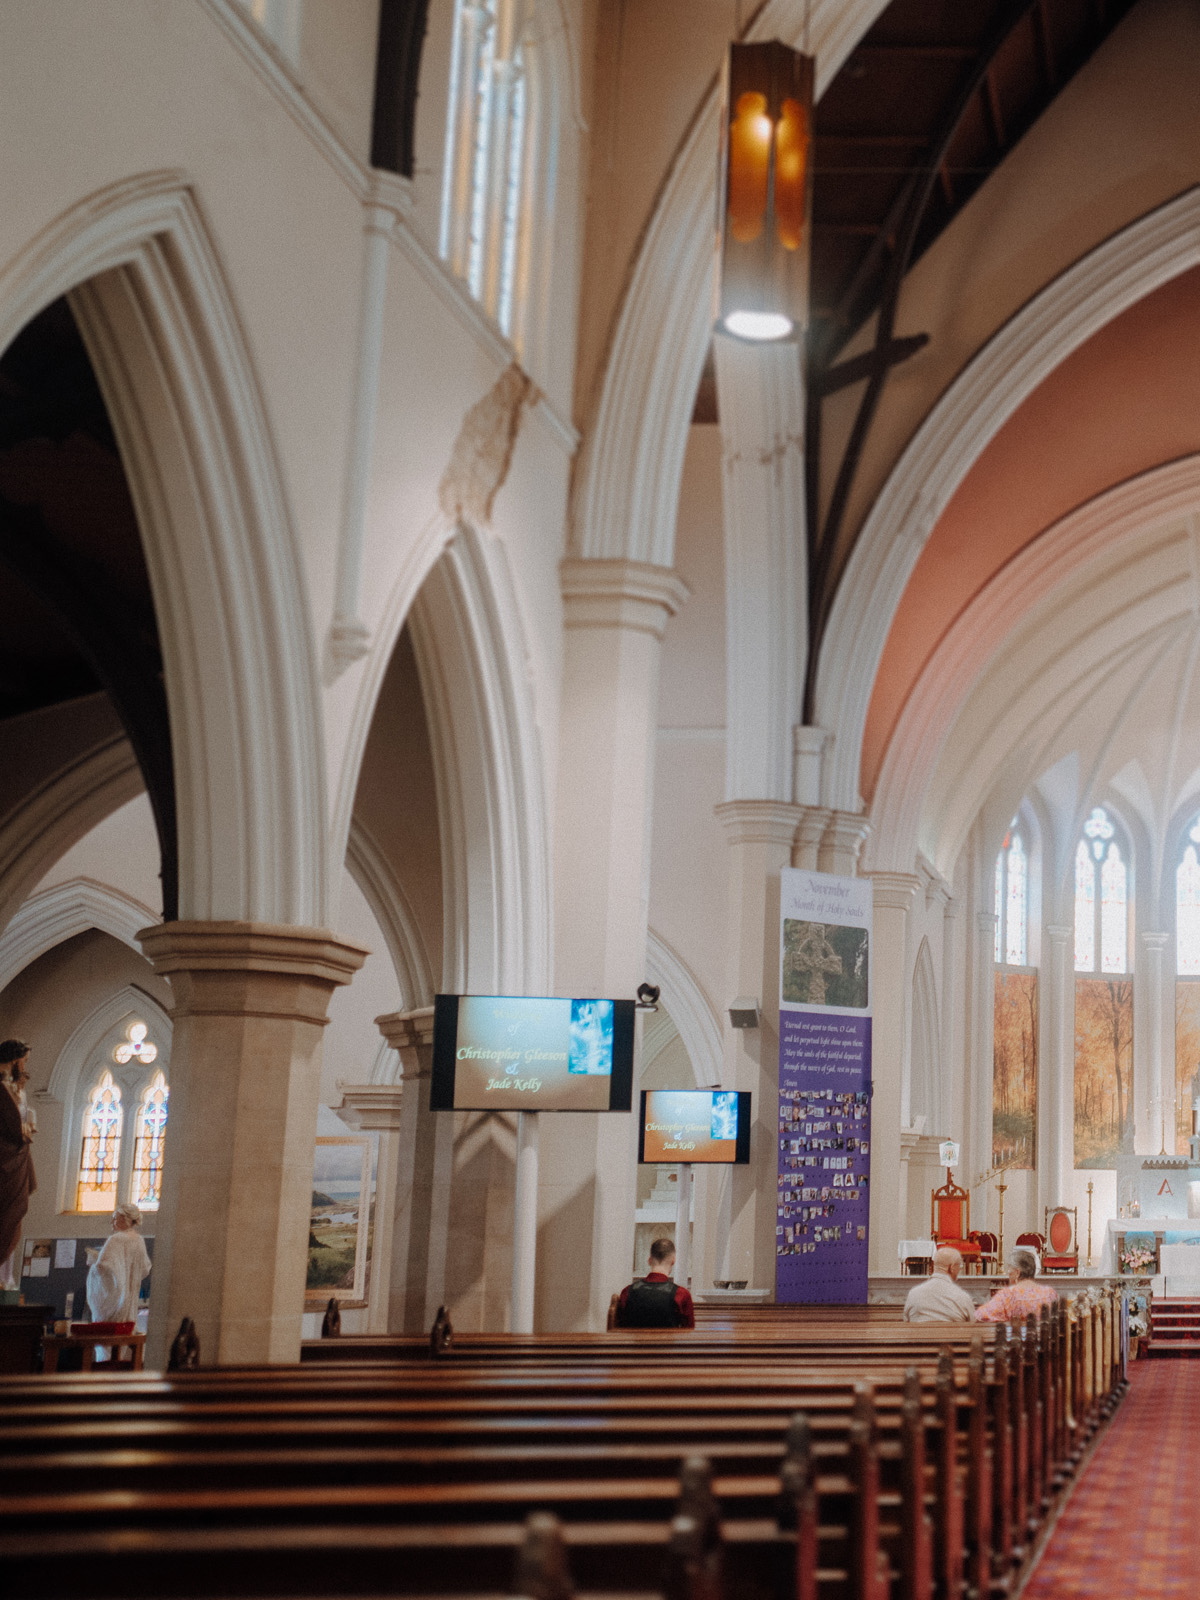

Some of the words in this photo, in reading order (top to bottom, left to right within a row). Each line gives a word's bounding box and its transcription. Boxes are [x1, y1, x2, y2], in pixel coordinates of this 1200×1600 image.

[804, 880, 850, 898] November
[790, 897, 815, 911] Month
[816, 900, 825, 916] of
[825, 902, 845, 918] Holy
[845, 905, 864, 918] Souls
[507, 1022, 521, 1036] of
[784, 1021, 801, 1030] Eternal
[800, 1037, 820, 1045] perpetual
[820, 1037, 830, 1047] light
[456, 1046, 521, 1063] Christopher
[524, 1047, 567, 1063] Gleeson
[784, 1049, 796, 1059] May
[804, 1050, 814, 1058] souls
[815, 1050, 820, 1060] of
[827, 1050, 843, 1061] faithful
[505, 1062, 520, 1075] &
[784, 1062, 799, 1072] through
[808, 1065, 820, 1074] mercy
[821, 1063, 827, 1074] of
[486, 1077, 511, 1091] Jade
[514, 1078, 543, 1093] Kelly
[645, 1122, 684, 1133] Christopher
[674, 1131, 682, 1140] &
[663, 1142, 677, 1150] Jade
[679, 1142, 696, 1151] Kelly
